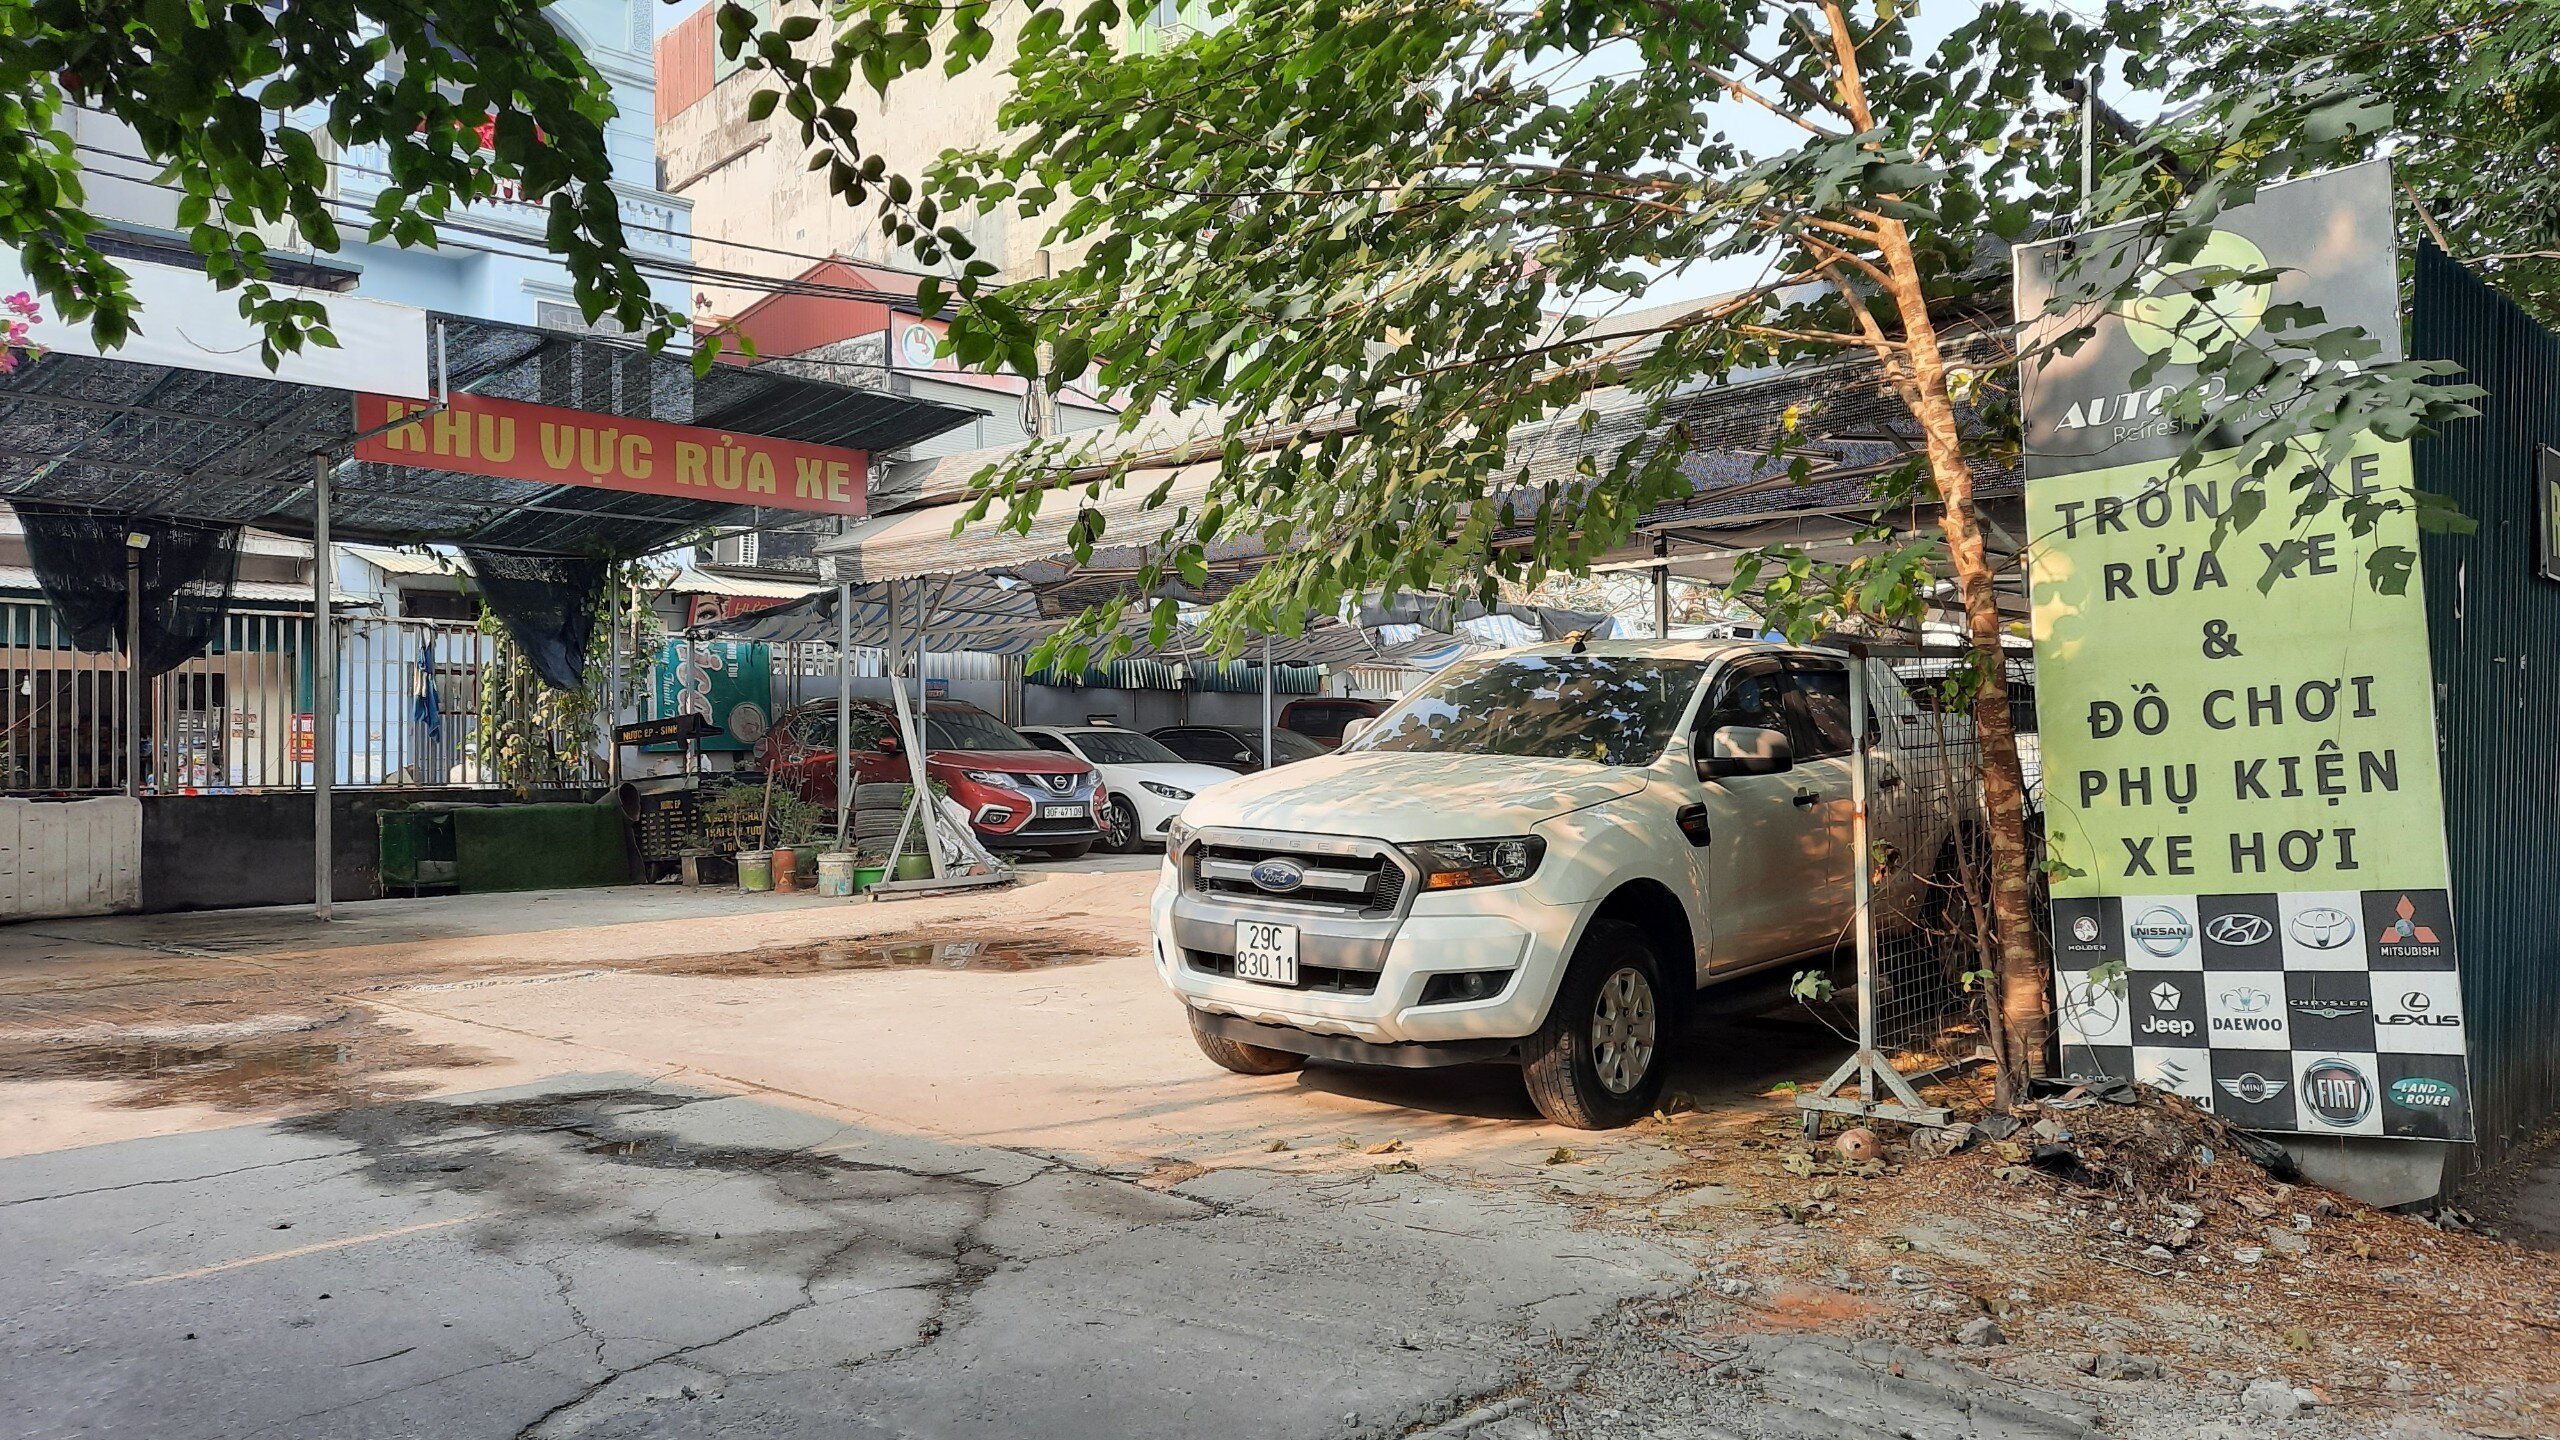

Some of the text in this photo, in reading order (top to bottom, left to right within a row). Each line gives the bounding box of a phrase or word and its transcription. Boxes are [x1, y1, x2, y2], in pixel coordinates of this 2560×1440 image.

[2053, 384, 2178, 433] AUTO
[386, 401, 851, 502] KHU VỰC RỬA XE
[2104, 533, 2338, 602] RỬA XE
[2202, 619, 2244, 660] &
[2087, 675, 2377, 739] ĐỒ CHƠI
[2079, 738, 2399, 814] PHỤ KIỆN
[1212, 833, 1360, 853] RANGER
[2121, 828, 2359, 877] XE HƠI
[1260, 867, 1289, 884] Ford
[1250, 925, 1283, 952] 29C
[2136, 926, 2187, 936] NISSAN
[2067, 944, 2107, 952] HOLDEN
[2380, 946, 2440, 957] MITSUBISHI
[1237, 950, 1294, 982] 830.11
[2289, 999, 2369, 1007] CHRYSLER
[2140, 1013, 2195, 1038] Jeep
[2212, 1017, 2283, 1031] DAEWOO
[2374, 1013, 2461, 1027] LEXUS
[2241, 1083, 2264, 1094] MINI
[2316, 1078, 2357, 1110] FIAT
